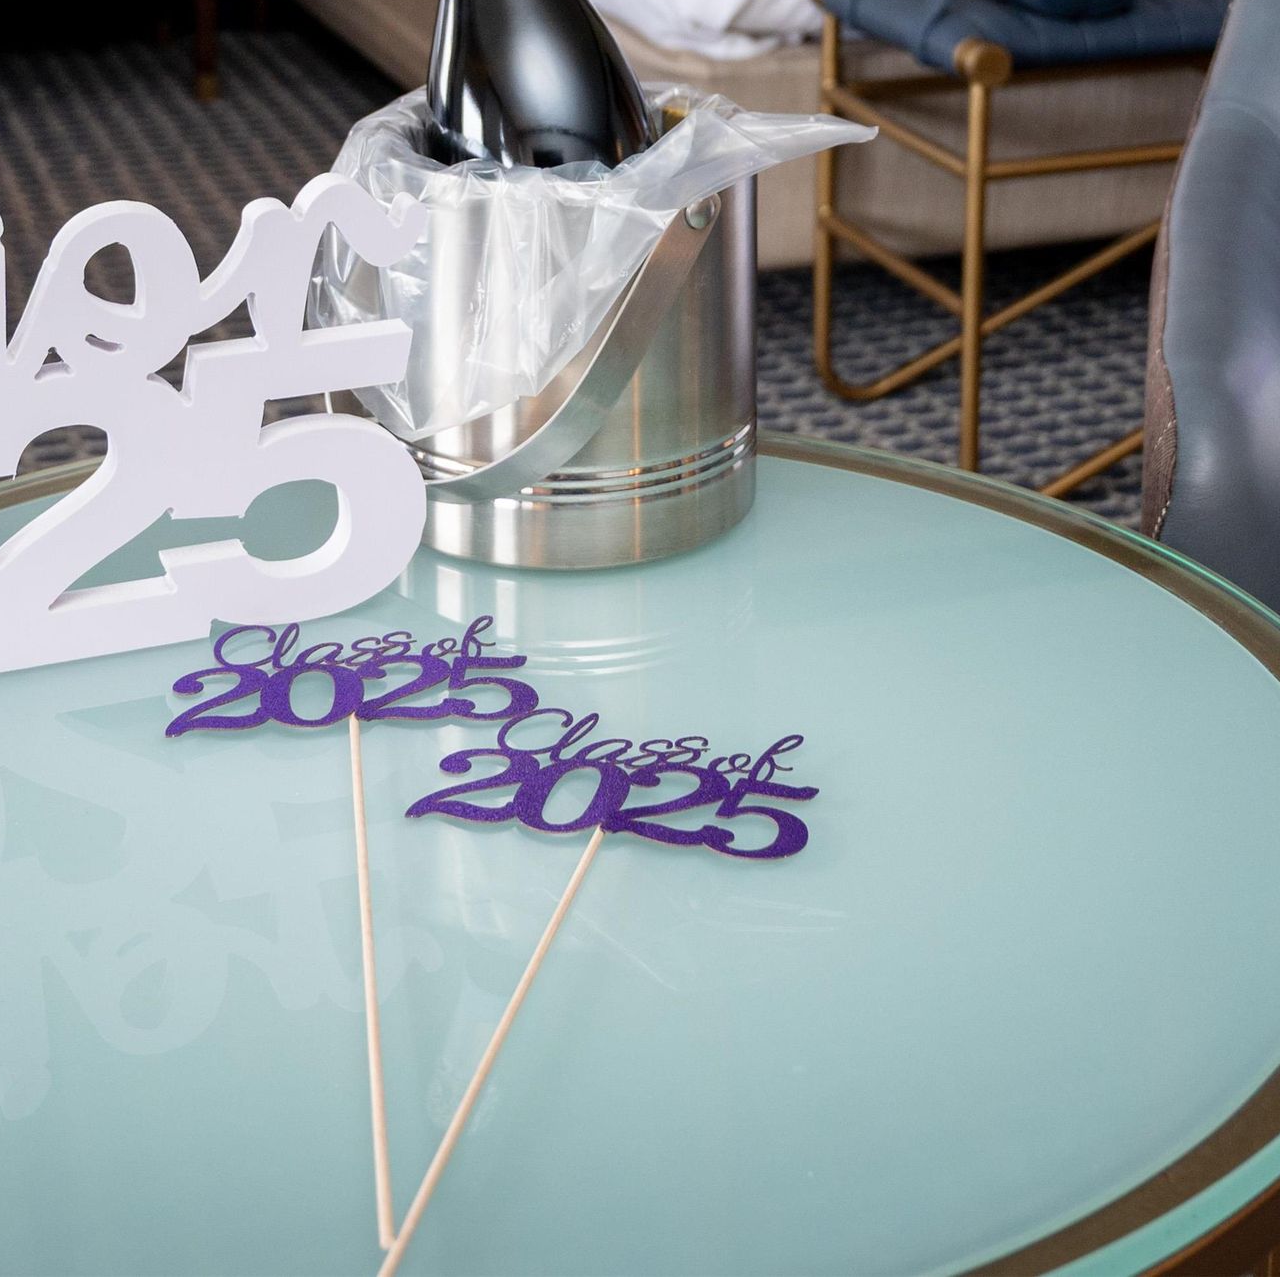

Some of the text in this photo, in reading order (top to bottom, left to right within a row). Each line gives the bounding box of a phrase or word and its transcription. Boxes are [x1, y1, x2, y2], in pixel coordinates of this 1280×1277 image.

[214, 615, 497, 671] Class of
[166, 654, 539, 738] 2025
[497, 708, 805, 782] Class of
[404, 748, 819, 860] 2025
